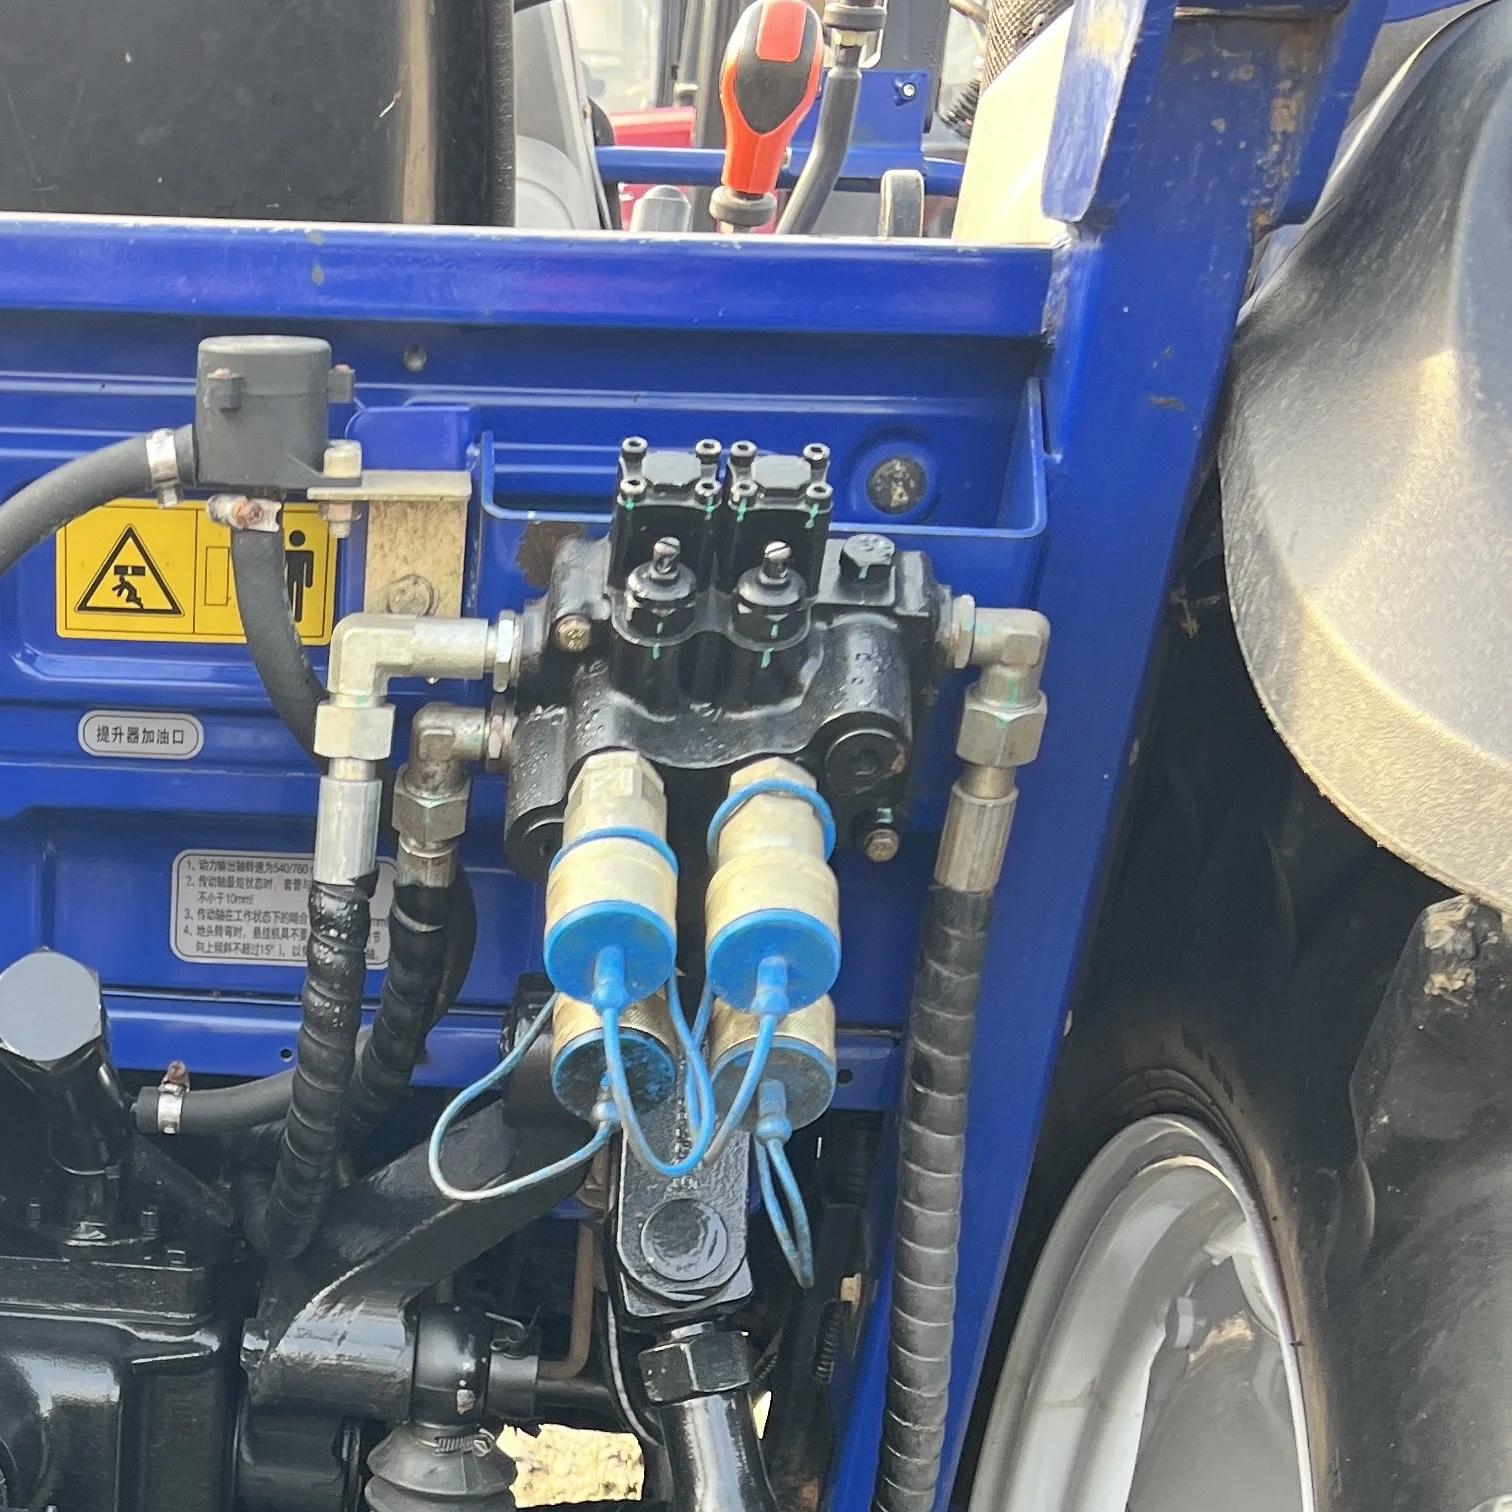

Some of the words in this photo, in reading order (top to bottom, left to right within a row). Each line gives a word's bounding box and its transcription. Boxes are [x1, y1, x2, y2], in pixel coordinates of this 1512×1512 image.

[96, 726, 185, 746] 提升器加油口
